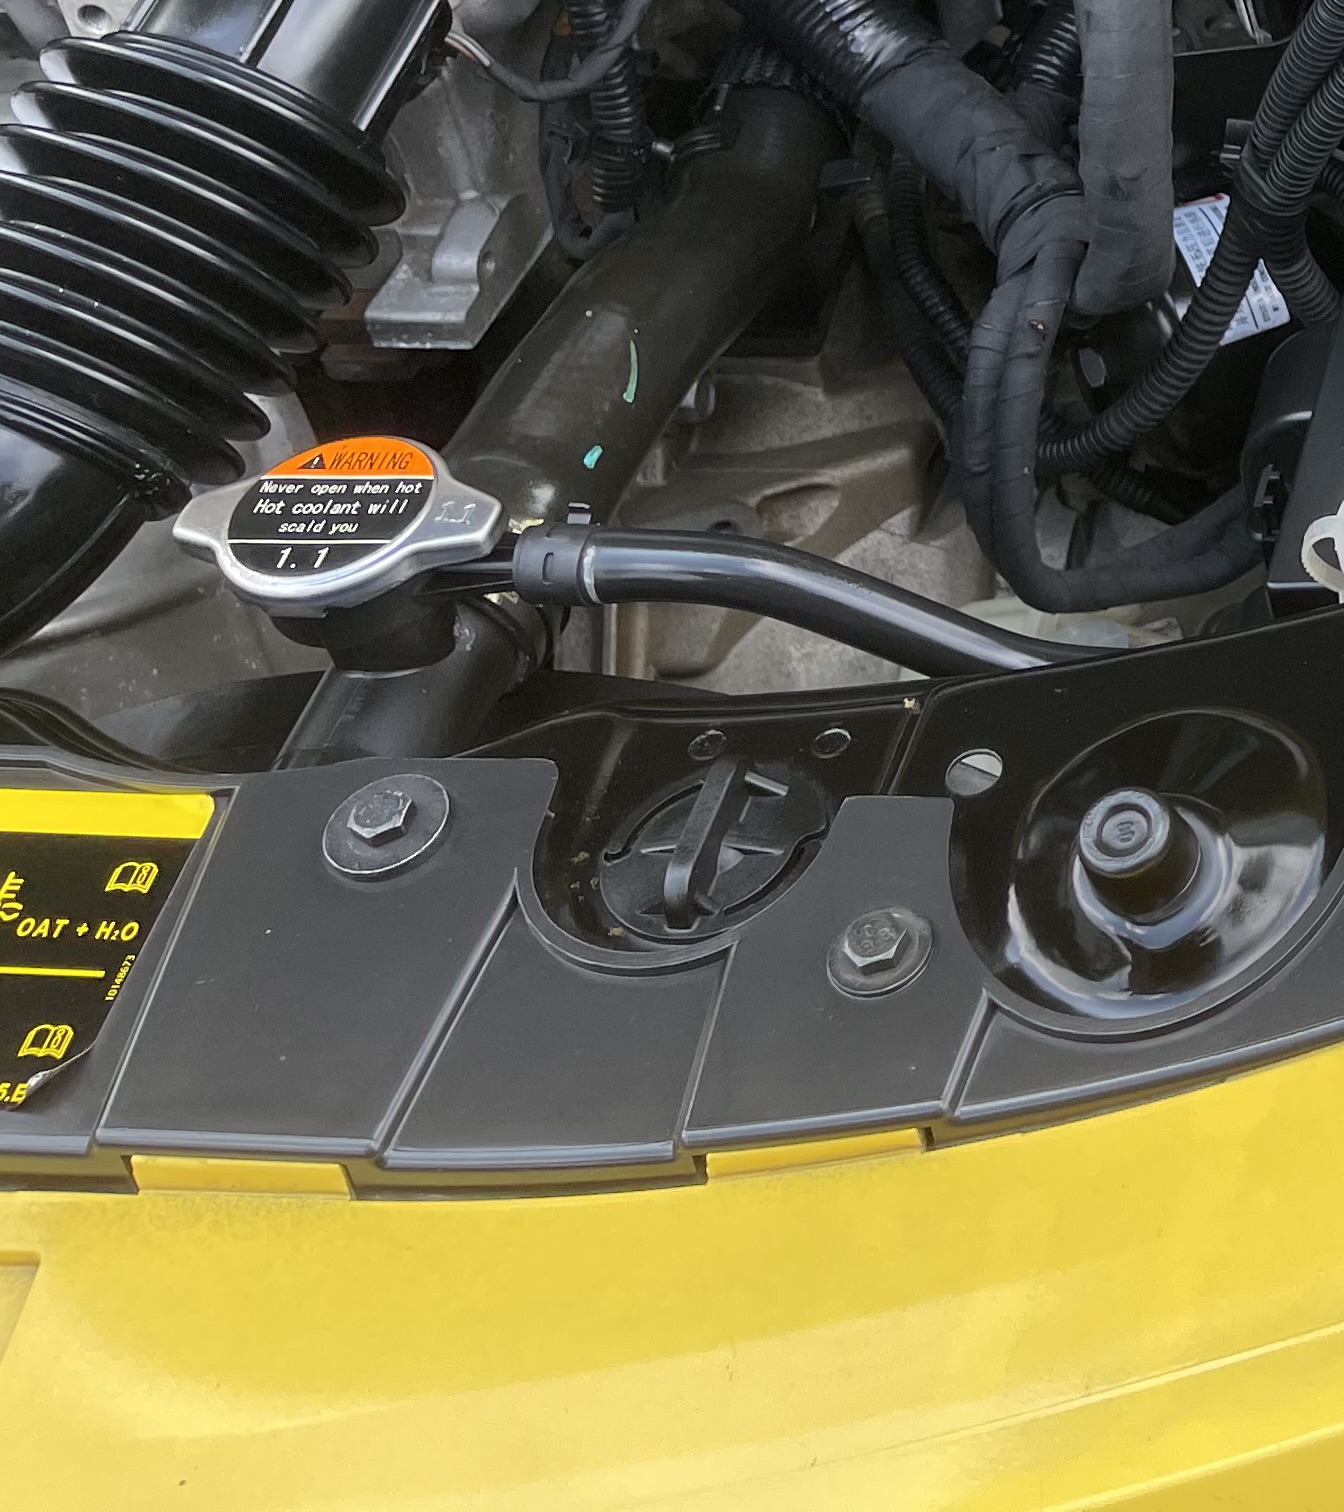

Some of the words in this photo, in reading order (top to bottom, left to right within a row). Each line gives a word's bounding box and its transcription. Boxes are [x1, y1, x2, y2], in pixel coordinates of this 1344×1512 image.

[330, 452, 413, 470] WARNING
[259, 481, 303, 494] Never
[311, 483, 347, 495] open
[354, 482, 389, 494] when
[395, 481, 422, 494] hot
[253, 501, 284, 515] Hot
[292, 500, 361, 515] coolant
[368, 500, 408, 514] will
[278, 520, 324, 533] scald
[329, 521, 359, 536] you
[16, 917, 69, 939] OAT
[76, 922, 89, 937] +
